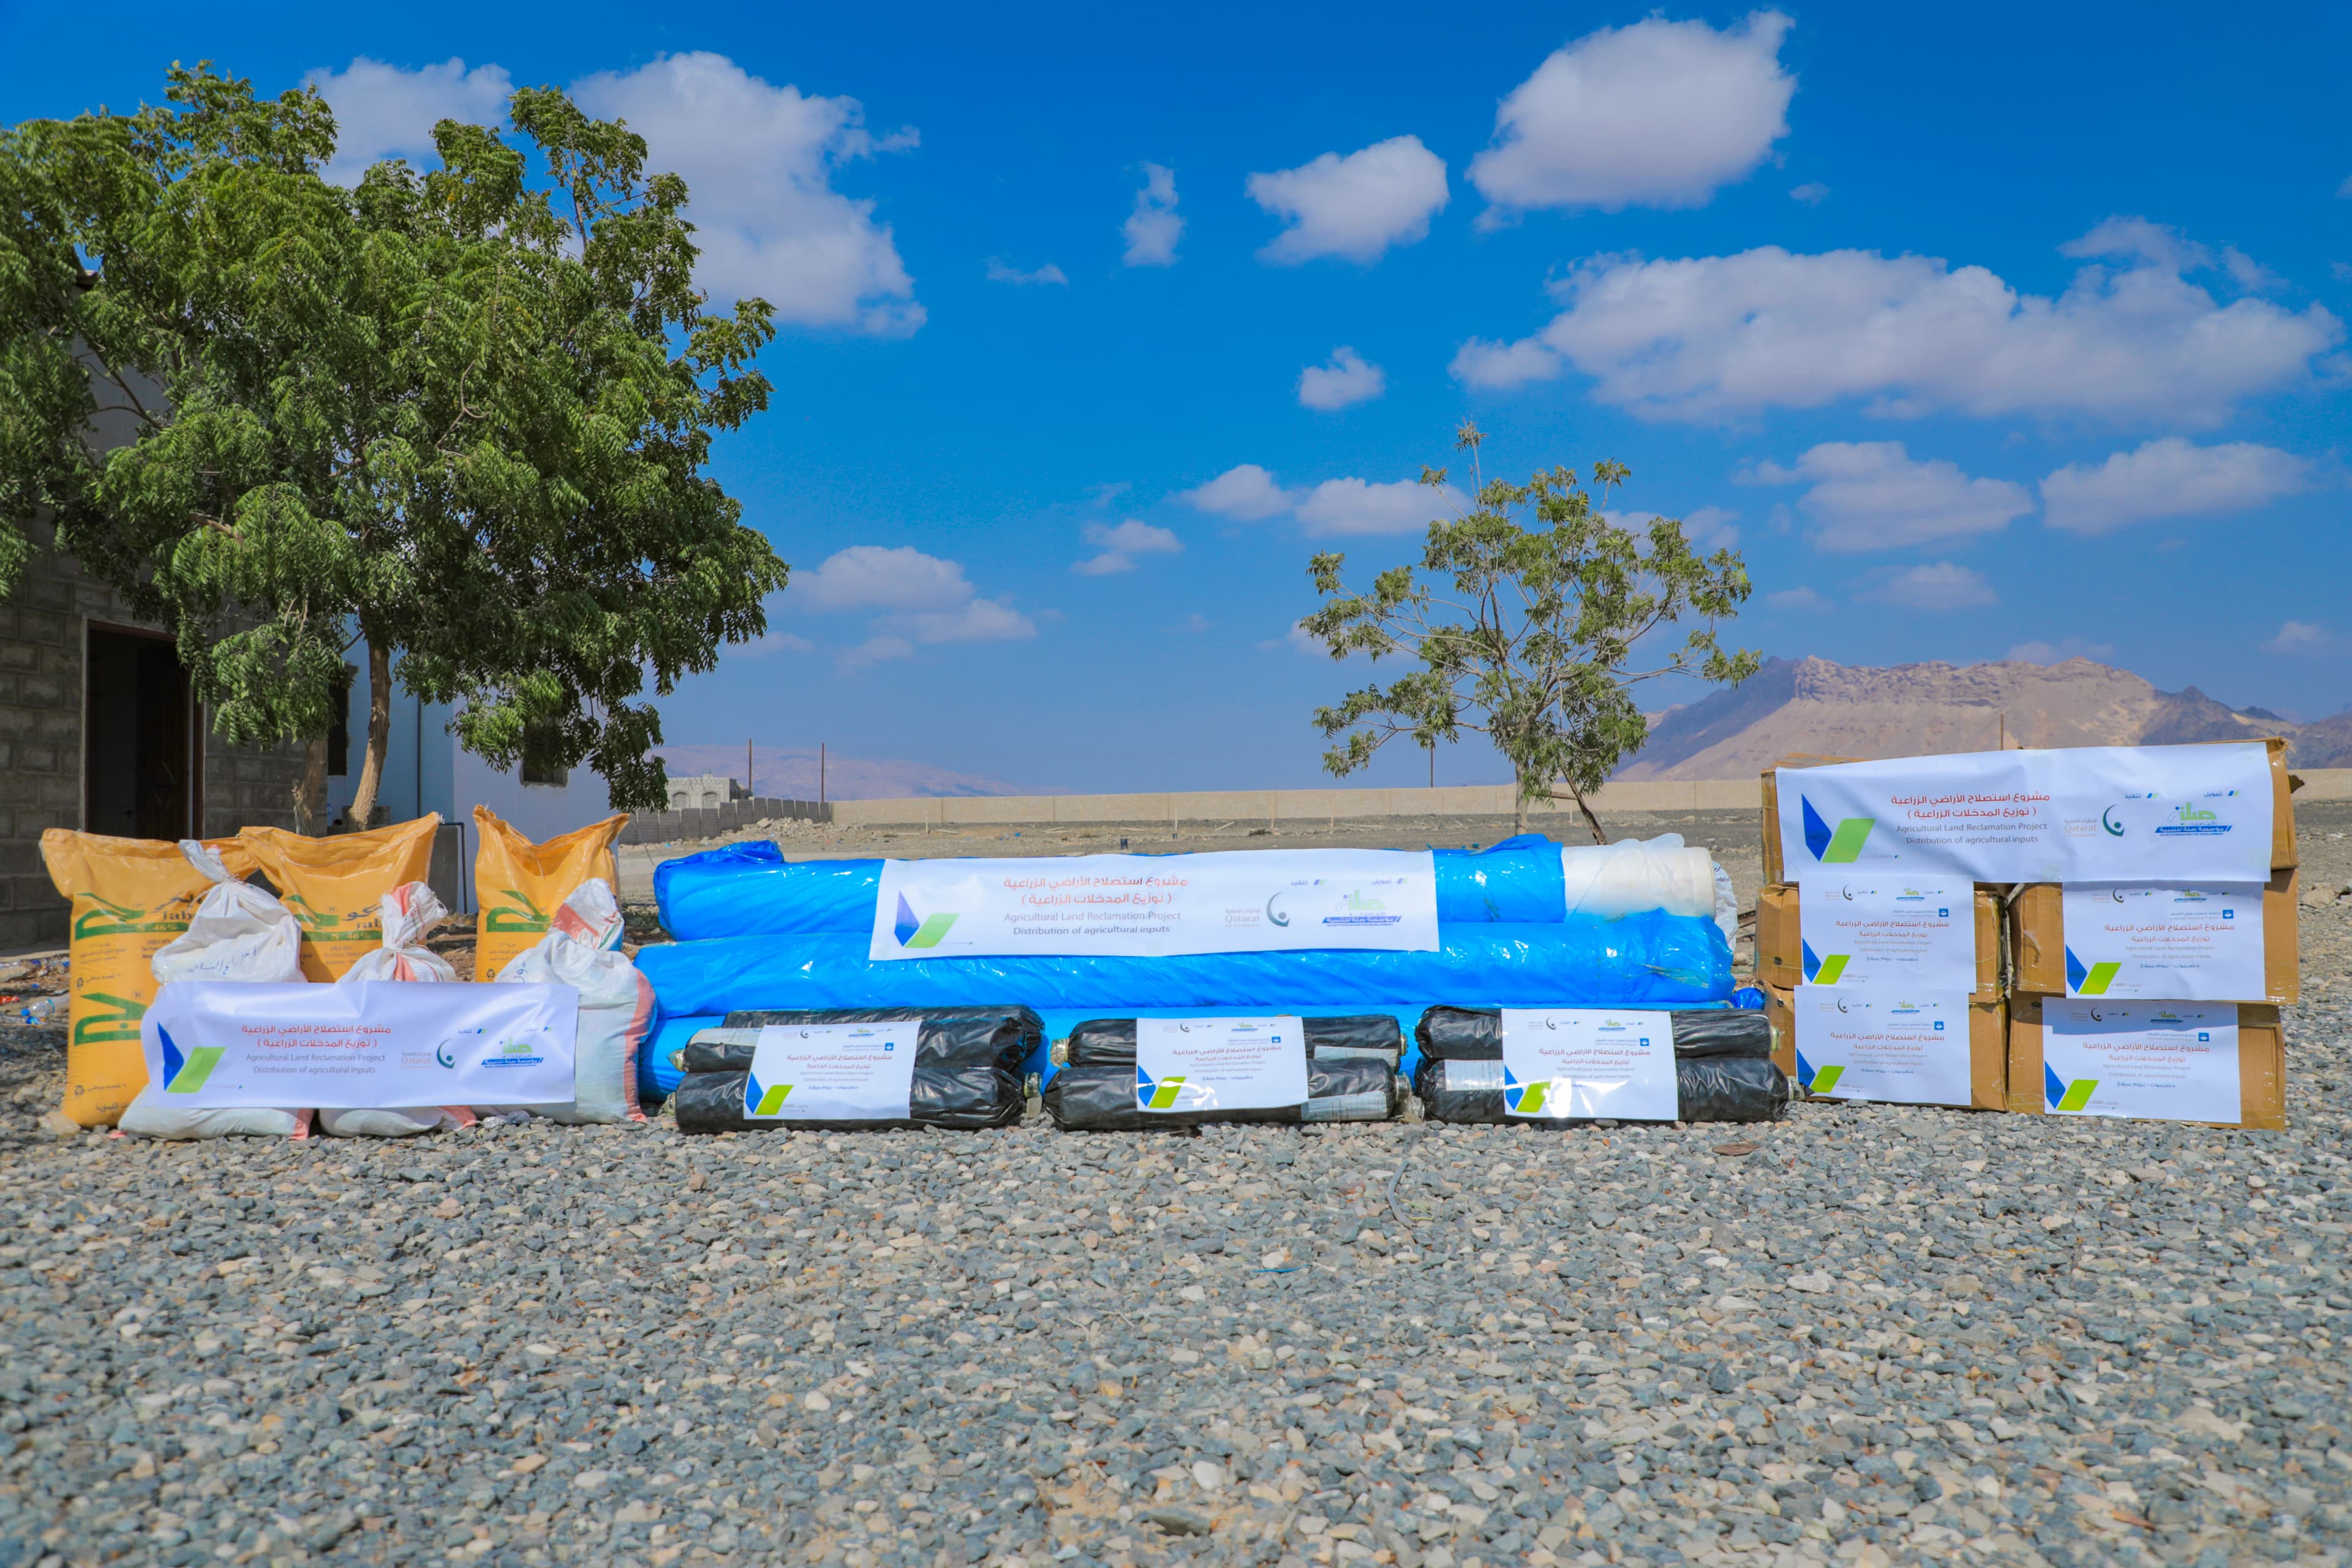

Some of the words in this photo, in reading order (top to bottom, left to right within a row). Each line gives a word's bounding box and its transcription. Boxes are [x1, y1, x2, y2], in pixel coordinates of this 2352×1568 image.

[1891, 796, 1926, 806] الزراعية
[1929, 794, 1965, 807] الأراضي
[1968, 794, 2010, 803] استصلاح
[2013, 791, 2049, 802] مشروع
[1914, 810, 1950, 820] الزراعية
[2003, 807, 2029, 817] توزيع
[1897, 825, 1942, 834] Agricultural
[1966, 836, 2010, 845] agricultural
[1004, 878, 1045, 891] الزراعية
[1049, 876, 1090, 891] الأراضي
[1093, 876, 1142, 888] استصلاح
[1146, 875, 1188, 886] مشروع
[1030, 894, 1070, 907] الزراعية
[1074, 894, 1129, 903] المدخلات
[1133, 893, 1164, 905] توزيع
[163, 911, 195, 921] Jab
[1005, 913, 1058, 923] Agricultural
[1148, 911, 1181, 921] Project
[1225, 914, 1259, 924] Qatarat
[1084, 926, 1137, 935] agricultural
[241, 1025, 276, 1035] الزراعية
[278, 1025, 311, 1036] الأراضي
[314, 1025, 353, 1034] استصلاح
[356, 1023, 391, 1034] مشروع
[263, 1039, 297, 1048] الزراعية
[345, 1039, 371, 1049] توزيع
[2180, 1044, 2209, 1052] مشروع
